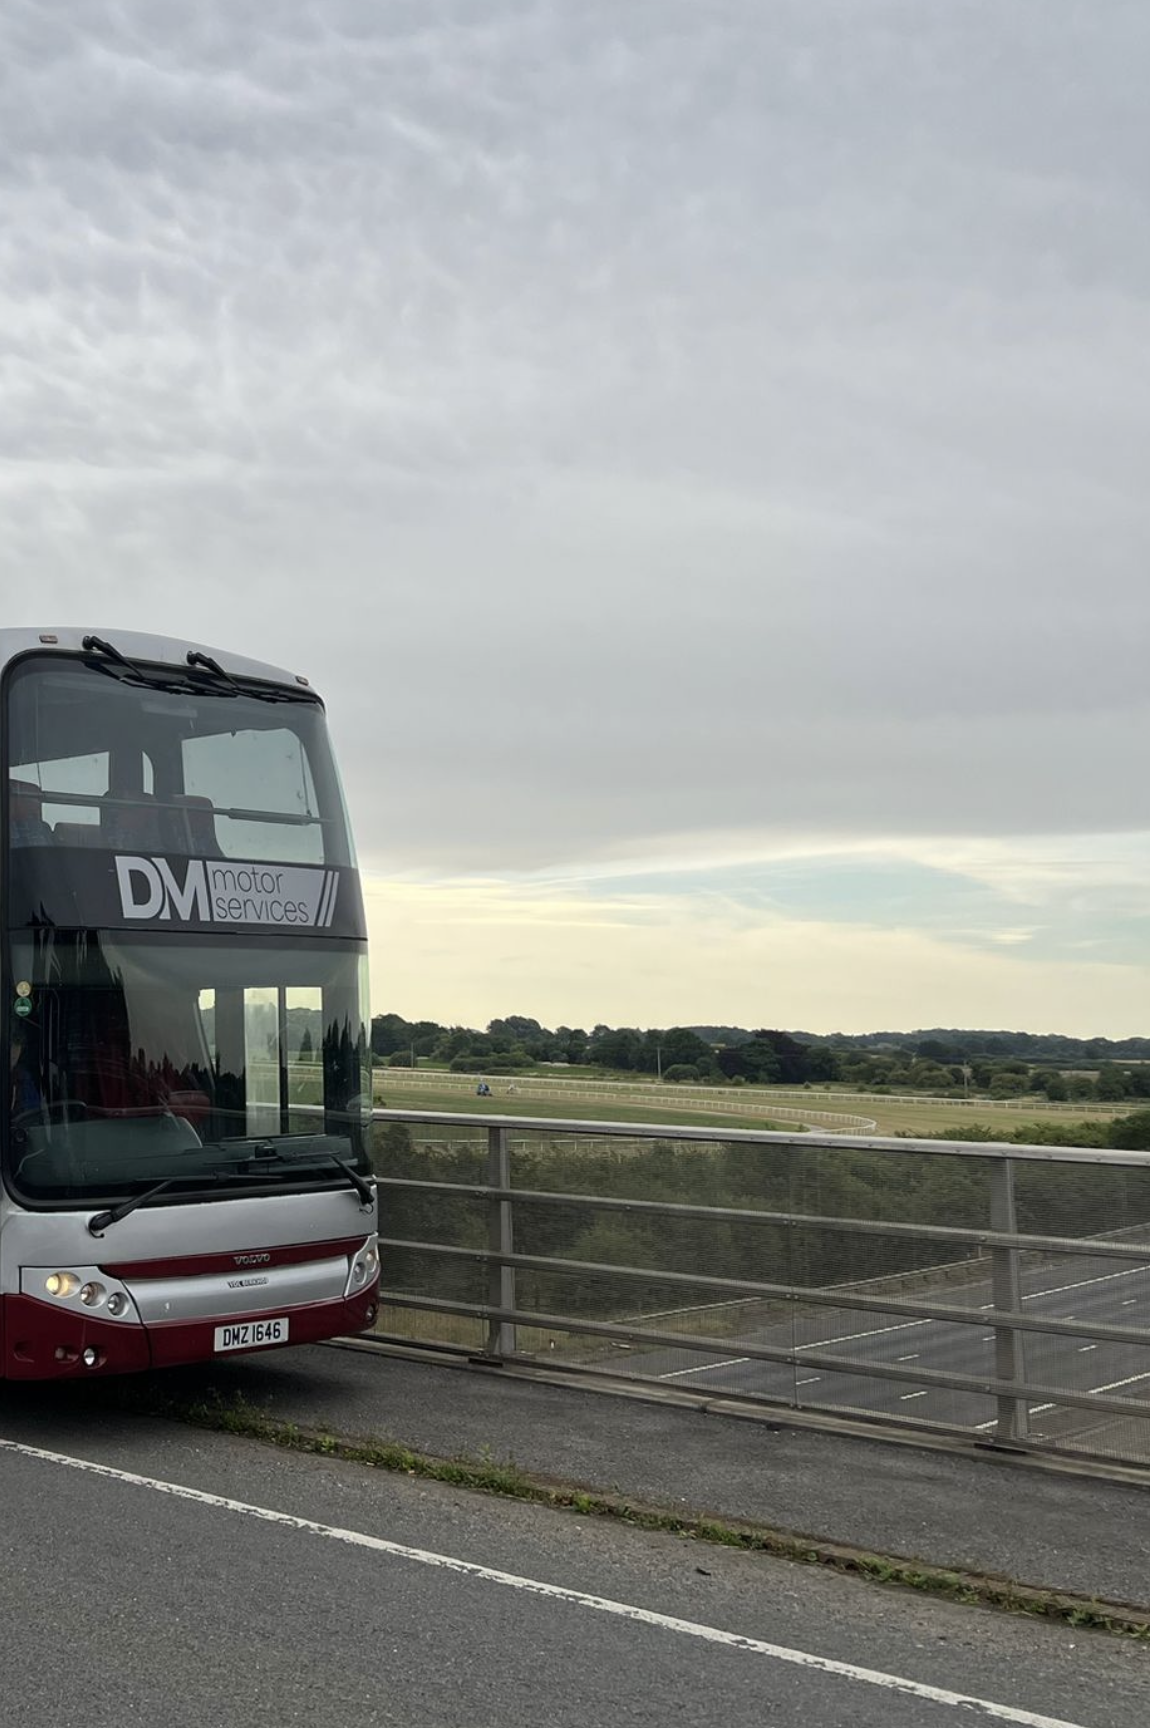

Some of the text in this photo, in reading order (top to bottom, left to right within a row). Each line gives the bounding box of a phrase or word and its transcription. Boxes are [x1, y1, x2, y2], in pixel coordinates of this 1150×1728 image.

[115, 855, 211, 922] DM
[212, 866, 284, 894] motor
[215, 897, 310, 923] services
[233, 1253, 270, 1265] VOLVO
[222, 1321, 281, 1347] DMZ 1646
